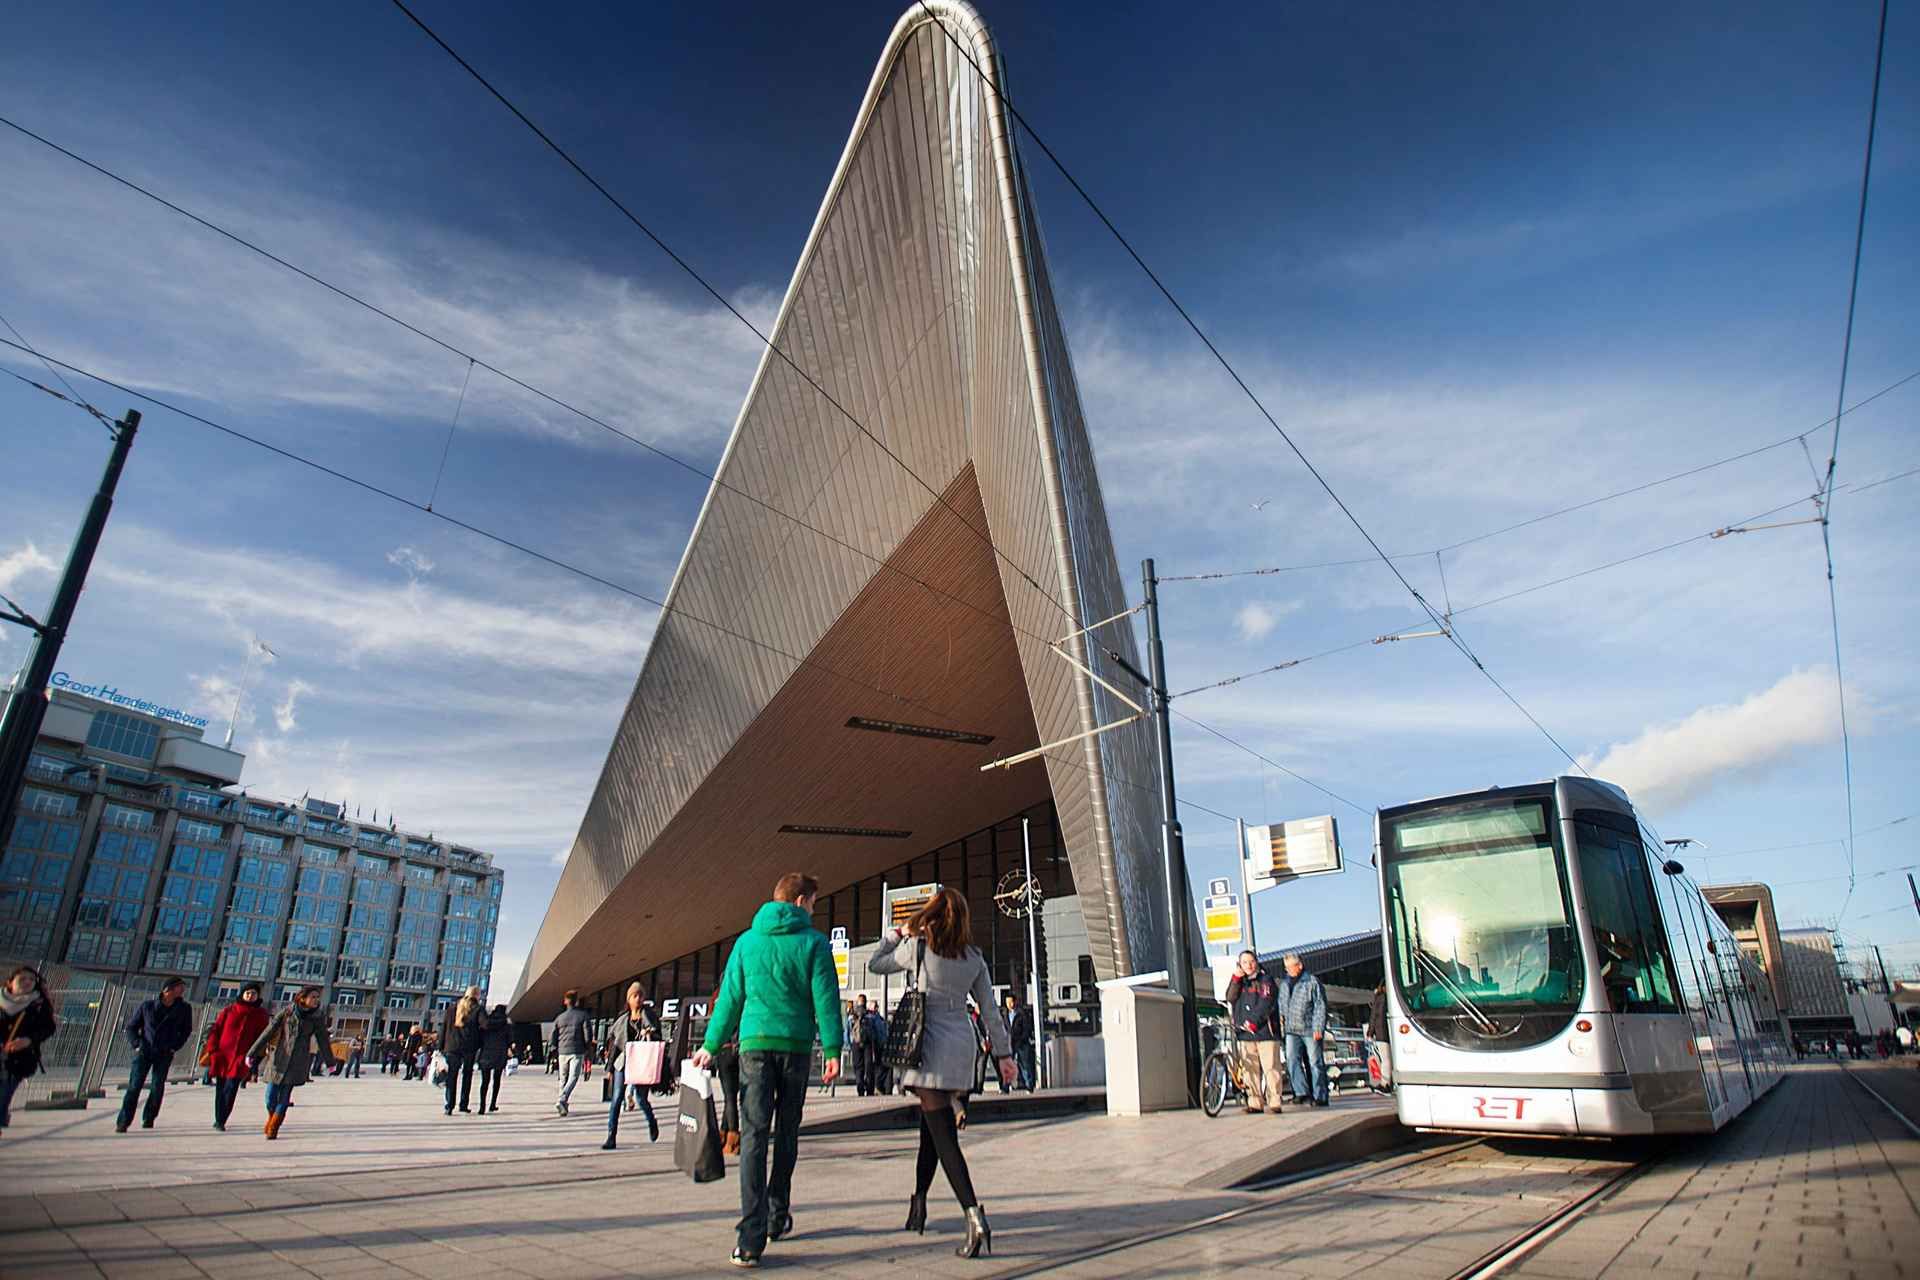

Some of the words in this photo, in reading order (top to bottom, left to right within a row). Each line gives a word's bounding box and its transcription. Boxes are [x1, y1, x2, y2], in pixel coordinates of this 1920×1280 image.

[51, 672, 96, 695] Groot
[98, 685, 208, 727] Handelsgebouw
[1215, 881, 1226, 893] B
[1473, 1097, 1533, 1119] RET
